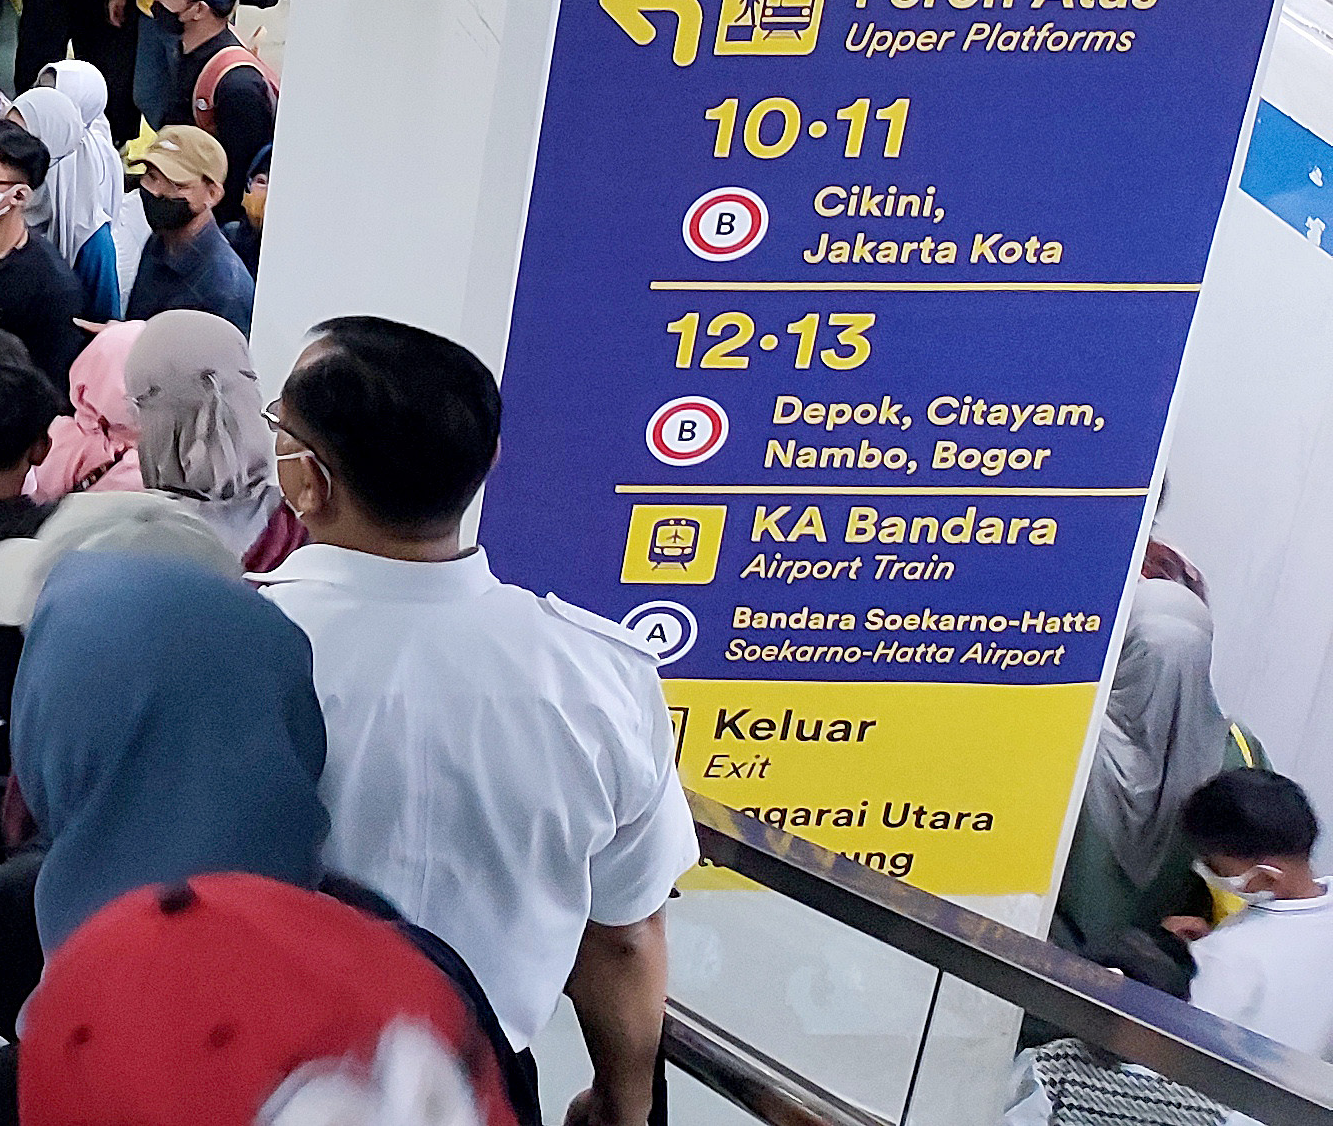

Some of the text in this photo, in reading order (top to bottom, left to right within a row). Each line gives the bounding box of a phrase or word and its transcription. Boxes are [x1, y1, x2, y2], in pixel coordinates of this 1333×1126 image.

[845, 22, 1136, 59] Upper Platforms
[814, 185, 945, 224] Cikini,
[715, 212, 736, 236] B
[803, 232, 1063, 264] Jakarta Kota
[772, 395, 1105, 432] Depok, Citayam,
[677, 420, 697, 442] B
[764, 439, 1052, 477] Nambo, Bogor
[750, 505, 1058, 545] KA Bandara
[739, 552, 955, 585] Airport Train
[645, 623, 668, 644] A
[732, 606, 1101, 634] Bandara Soekarno-Hatta
[724, 638, 1066, 670] Soekarno-Hatta Airport
[713, 708, 877, 743] Keluar
[703, 754, 772, 779] Exit
[882, 802, 994, 832] Utara
